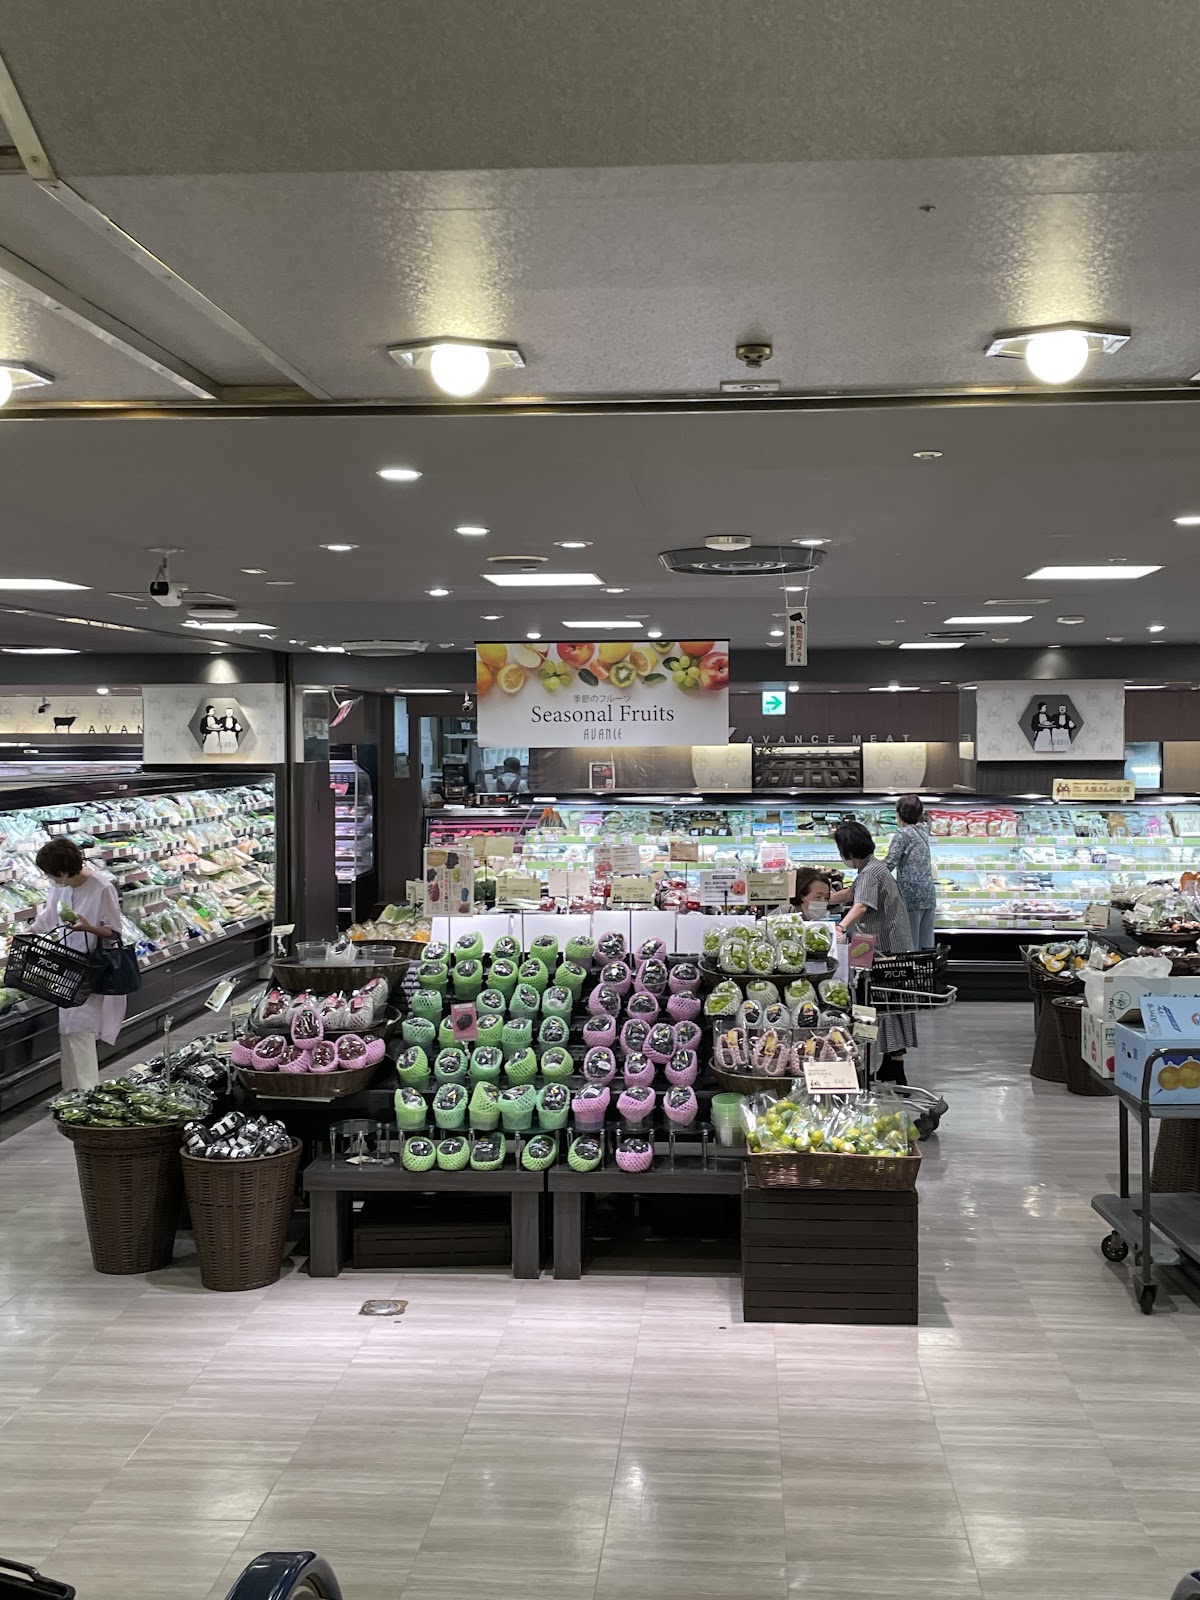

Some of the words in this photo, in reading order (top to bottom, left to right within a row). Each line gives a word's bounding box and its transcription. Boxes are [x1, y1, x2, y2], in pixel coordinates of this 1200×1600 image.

[573, 694, 632, 703] 季節のフルーツ
[531, 704, 612, 723] Seasonal
[619, 704, 675, 722] Fruits
[583, 727, 623, 740] AVANCE
[746, 734, 836, 744] AVANCE
[852, 734, 911, 743] MEAT
